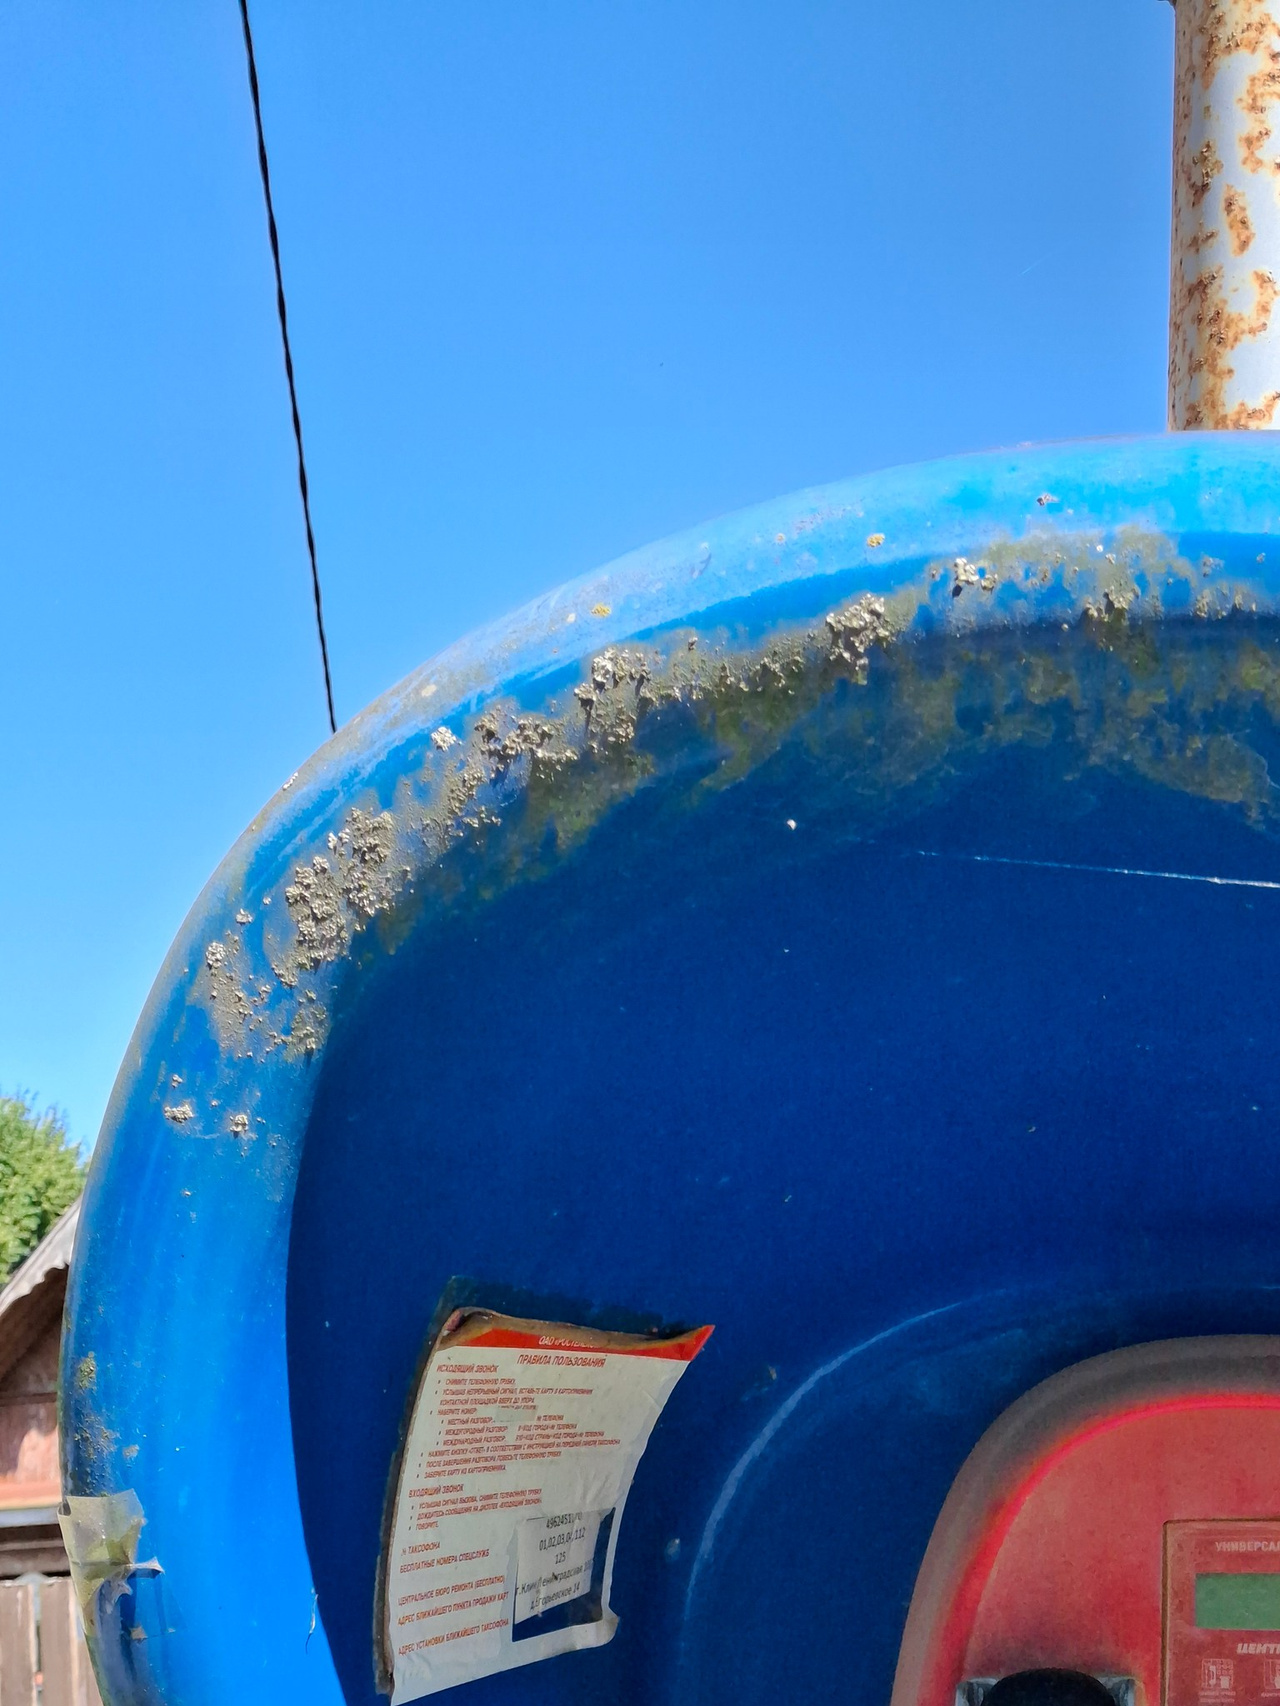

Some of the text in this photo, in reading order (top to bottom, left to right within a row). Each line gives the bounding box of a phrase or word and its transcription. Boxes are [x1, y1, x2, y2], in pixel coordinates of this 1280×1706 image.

[517, 1354, 606, 1368] ПРАВИЛА ПОЛЬЗОВАНИЯ
[400, 1548, 490, 1574] БЕСПЛАТНЫЕ НОМЕРА СПЕЦСЛУЖБ
[408, 1541, 441, 1555] ТАКСОФОНА
[555, 1551, 567, 1565] 125
[398, 1590, 434, 1607] ЦЕНТРАЛЬНОЕ
[435, 1586, 450, 1597] БЮРО
[451, 1581, 474, 1593] РЕМОНТА
[398, 1591, 509, 1626] АДРЕС БЛИЖАЙШЕГО ПУНКТА ПРОДАЖИ КАРТ
[399, 1618, 510, 1656] АДРЕС УСТАНОВКИ БЛИЖАЙШЕГО ТАКСОФОНА
